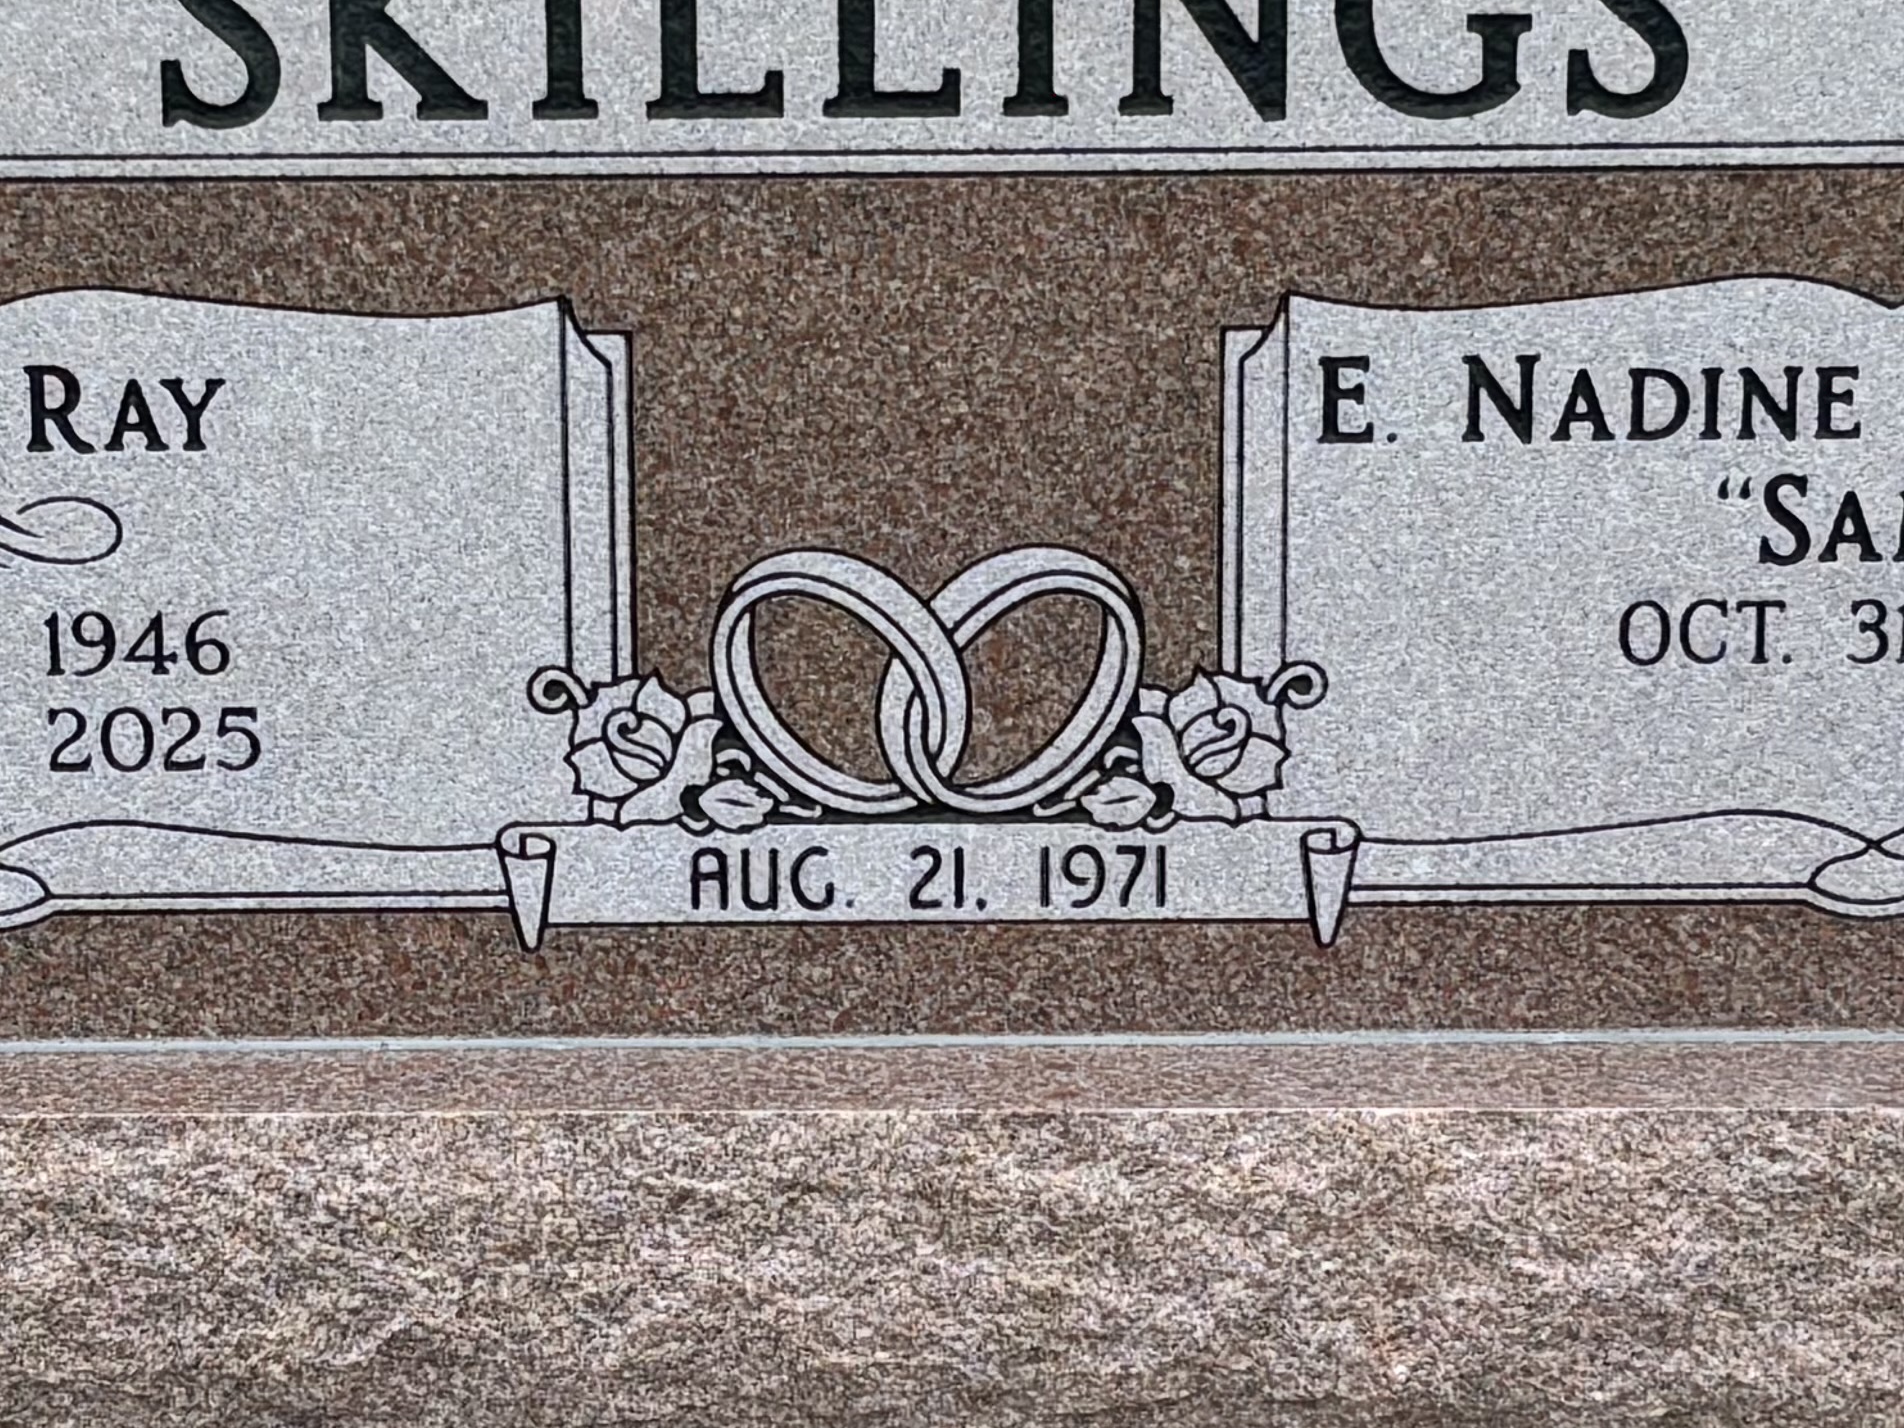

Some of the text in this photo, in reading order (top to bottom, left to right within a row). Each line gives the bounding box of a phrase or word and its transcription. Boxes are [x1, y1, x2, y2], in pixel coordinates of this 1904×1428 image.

[23, 364, 226, 454] RAY
[1317, 355, 1397, 444] E.
[1461, 353, 1861, 444] NADINE
[44, 609, 230, 677] 1946
[1619, 598, 1792, 666] OCT.
[47, 706, 261, 772] 2025
[689, 846, 855, 911] AUG.
[1040, 844, 1166, 909] 1971
